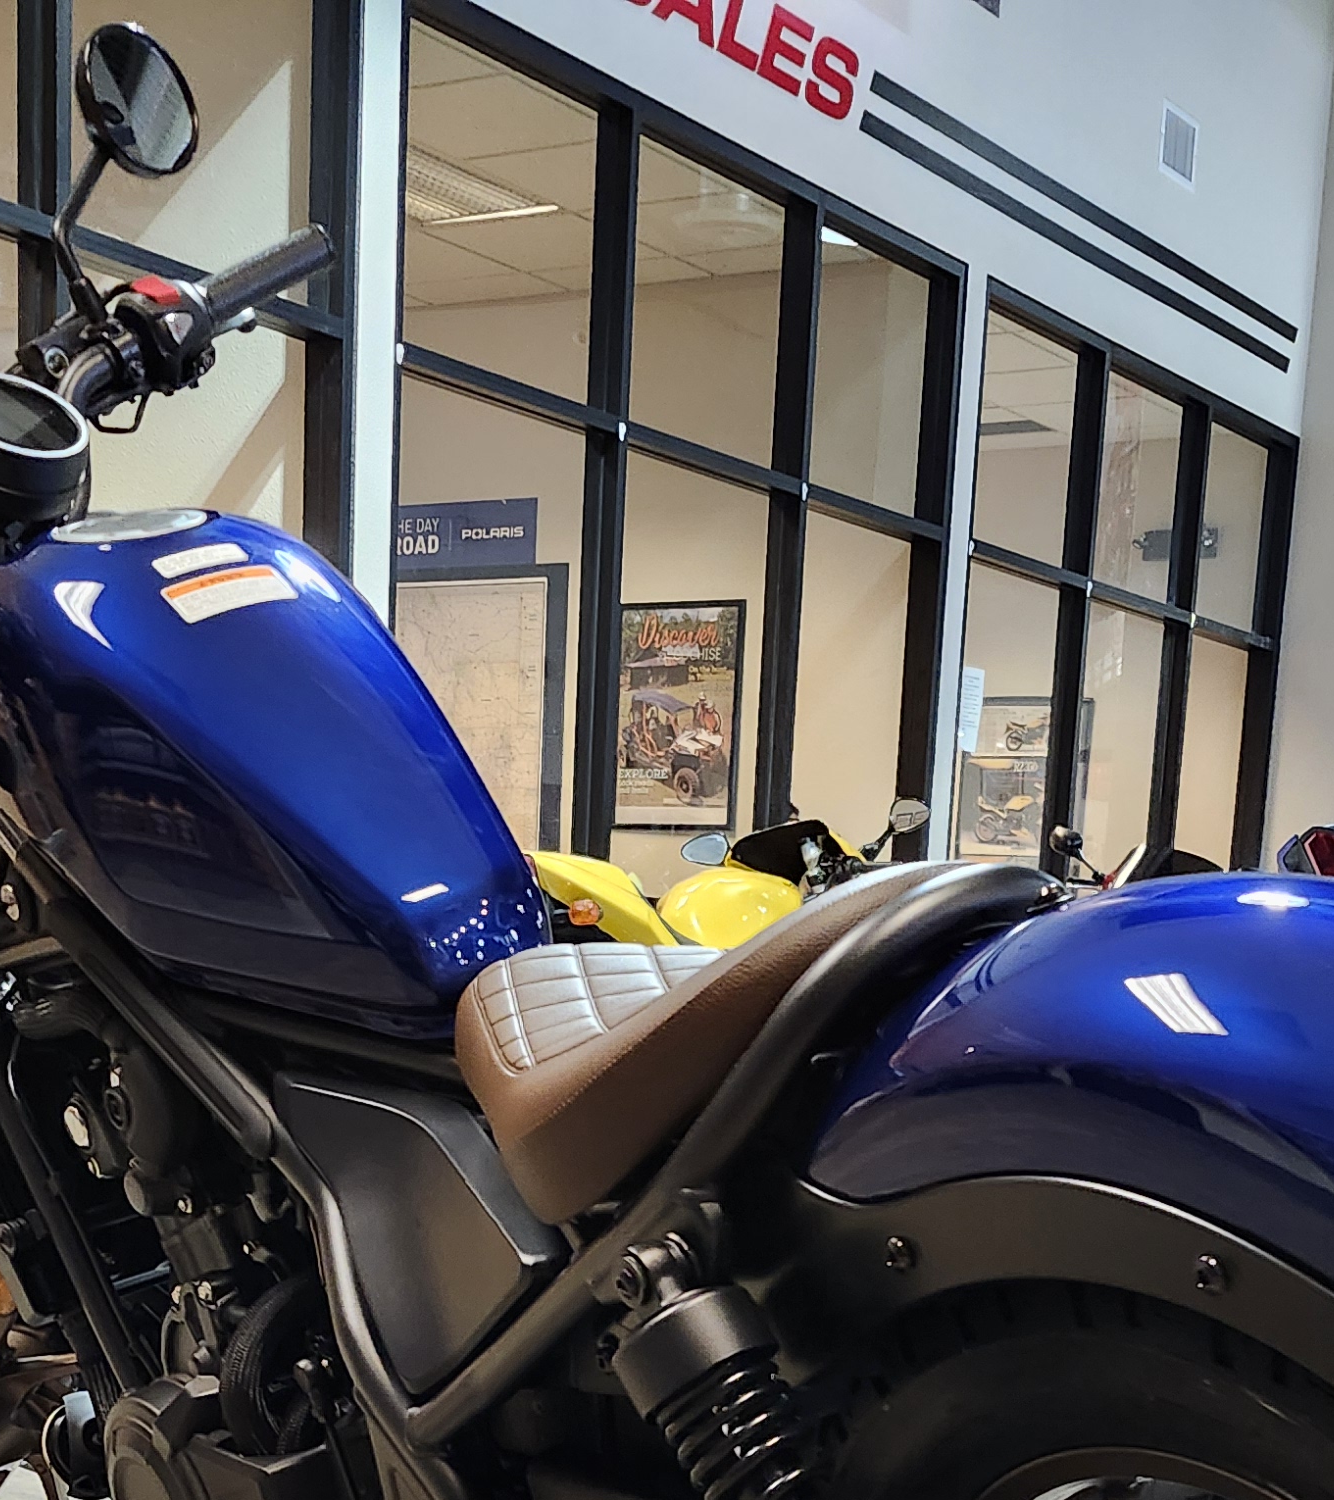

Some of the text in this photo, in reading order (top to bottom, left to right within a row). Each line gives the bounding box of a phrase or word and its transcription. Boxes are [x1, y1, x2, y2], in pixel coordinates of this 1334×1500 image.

[626, 0, 859, 120] ALES
[397, 517, 440, 534] HE DAY
[461, 526, 525, 541] POLARIS
[638, 613, 720, 650] Discover
[618, 768, 669, 780] EXPLORE
